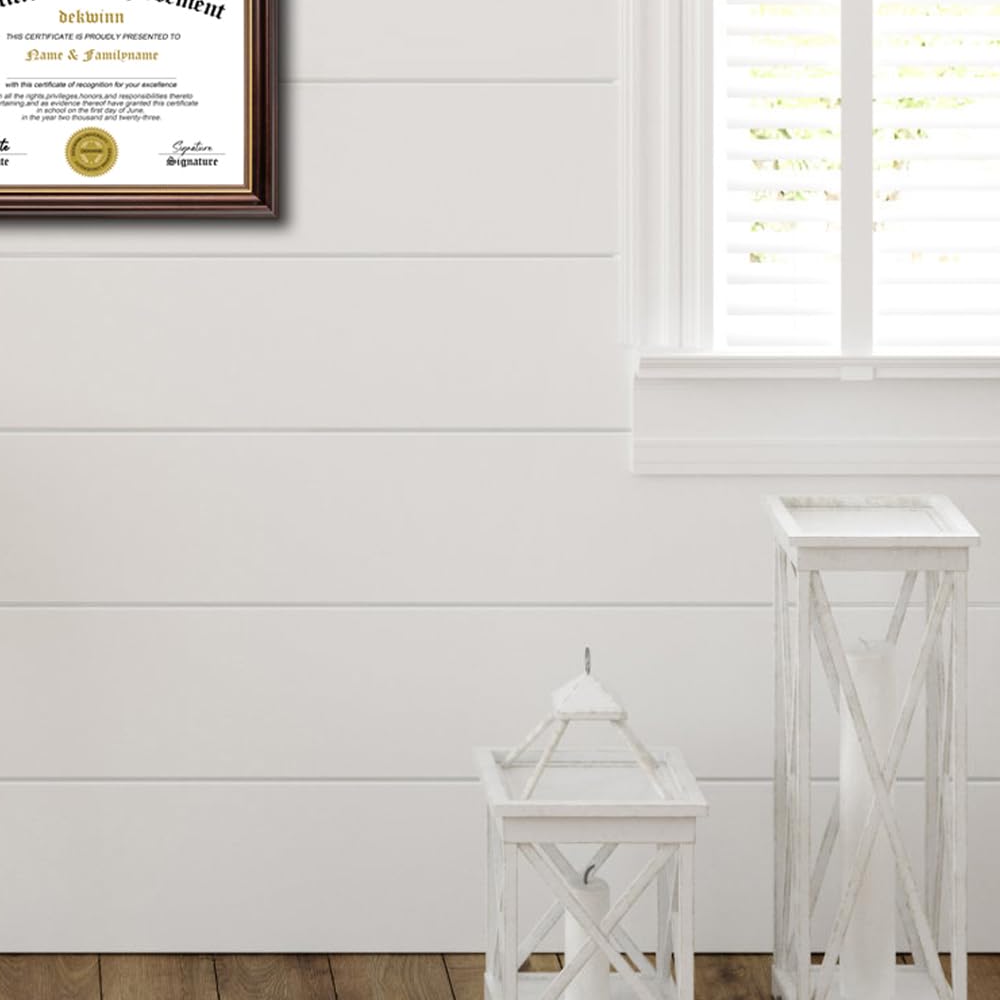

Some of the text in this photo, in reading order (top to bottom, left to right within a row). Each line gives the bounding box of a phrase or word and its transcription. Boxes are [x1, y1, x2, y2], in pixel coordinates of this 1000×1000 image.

[58, 9, 124, 24] dekwinn
[6, 32, 181, 41] THIS CERTIFICATE IS PROUDLY PRESENTED TO
[25, 48, 64, 62] Name
[67, 48, 79, 61] &
[75, 81, 113, 90] recognition
[124, 82, 141, 90] your
[166, 155, 219, 168] Signature
